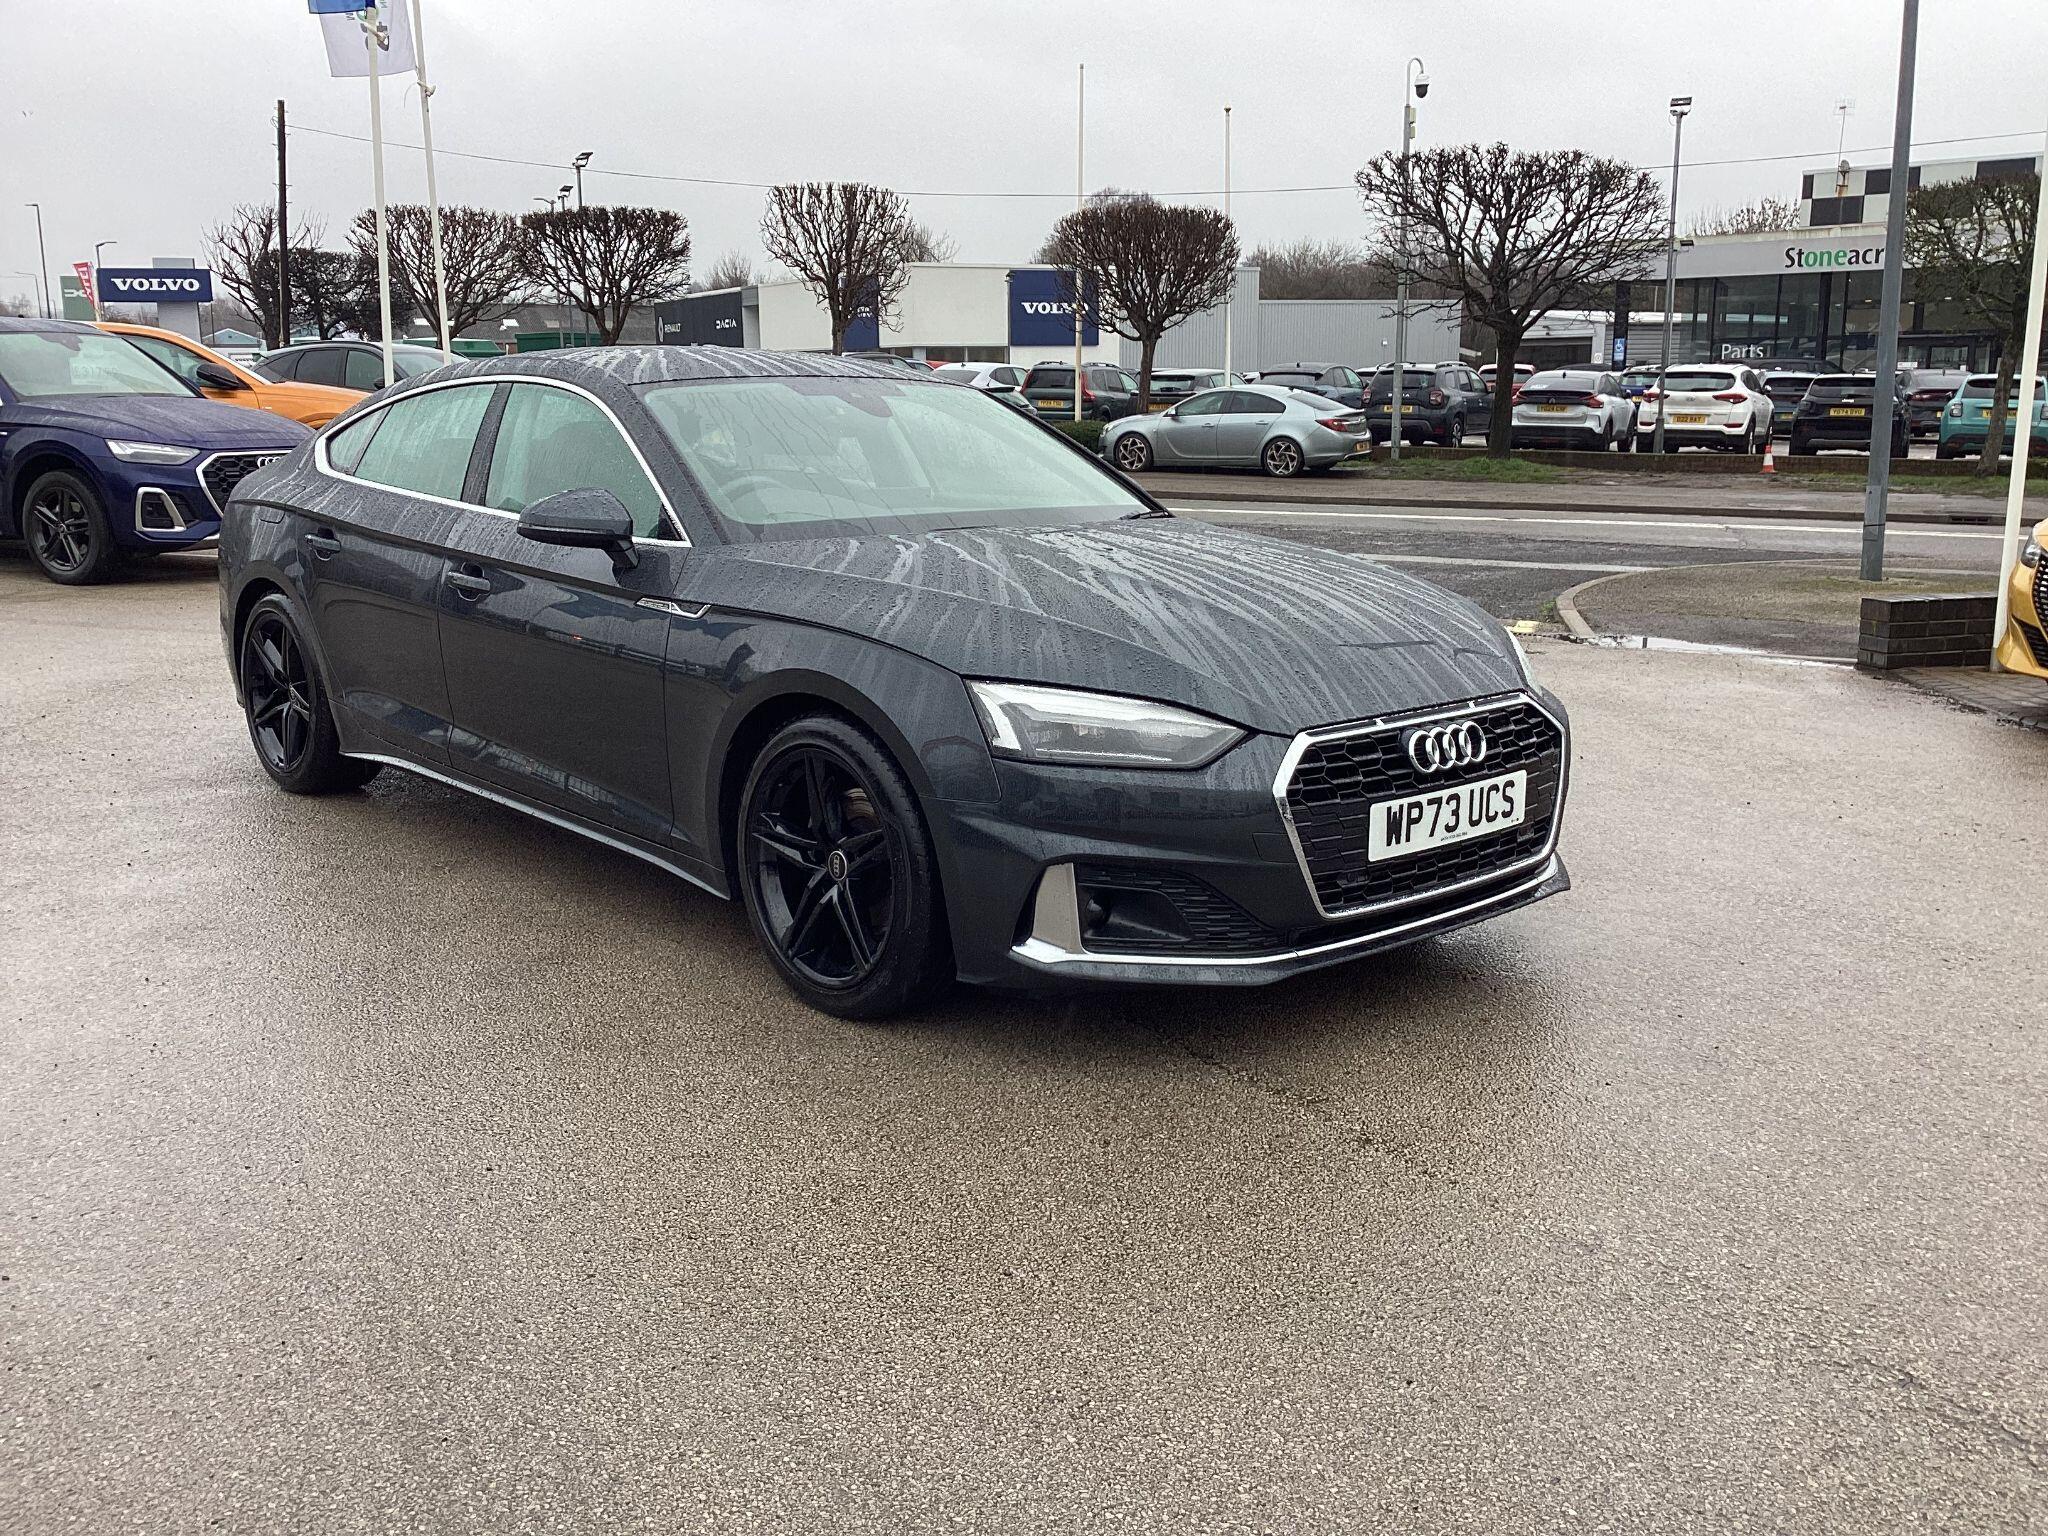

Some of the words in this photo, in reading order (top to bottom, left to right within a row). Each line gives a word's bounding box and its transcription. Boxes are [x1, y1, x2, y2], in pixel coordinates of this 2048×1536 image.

[1784, 246, 1885, 268] Stoneacr
[111, 278, 200, 291] VOLVO
[716, 319, 737, 330] DACIA
[1721, 343, 1764, 360] Parts
[1386, 793, 1461, 847] WP73
[1468, 780, 1515, 828] UCS
